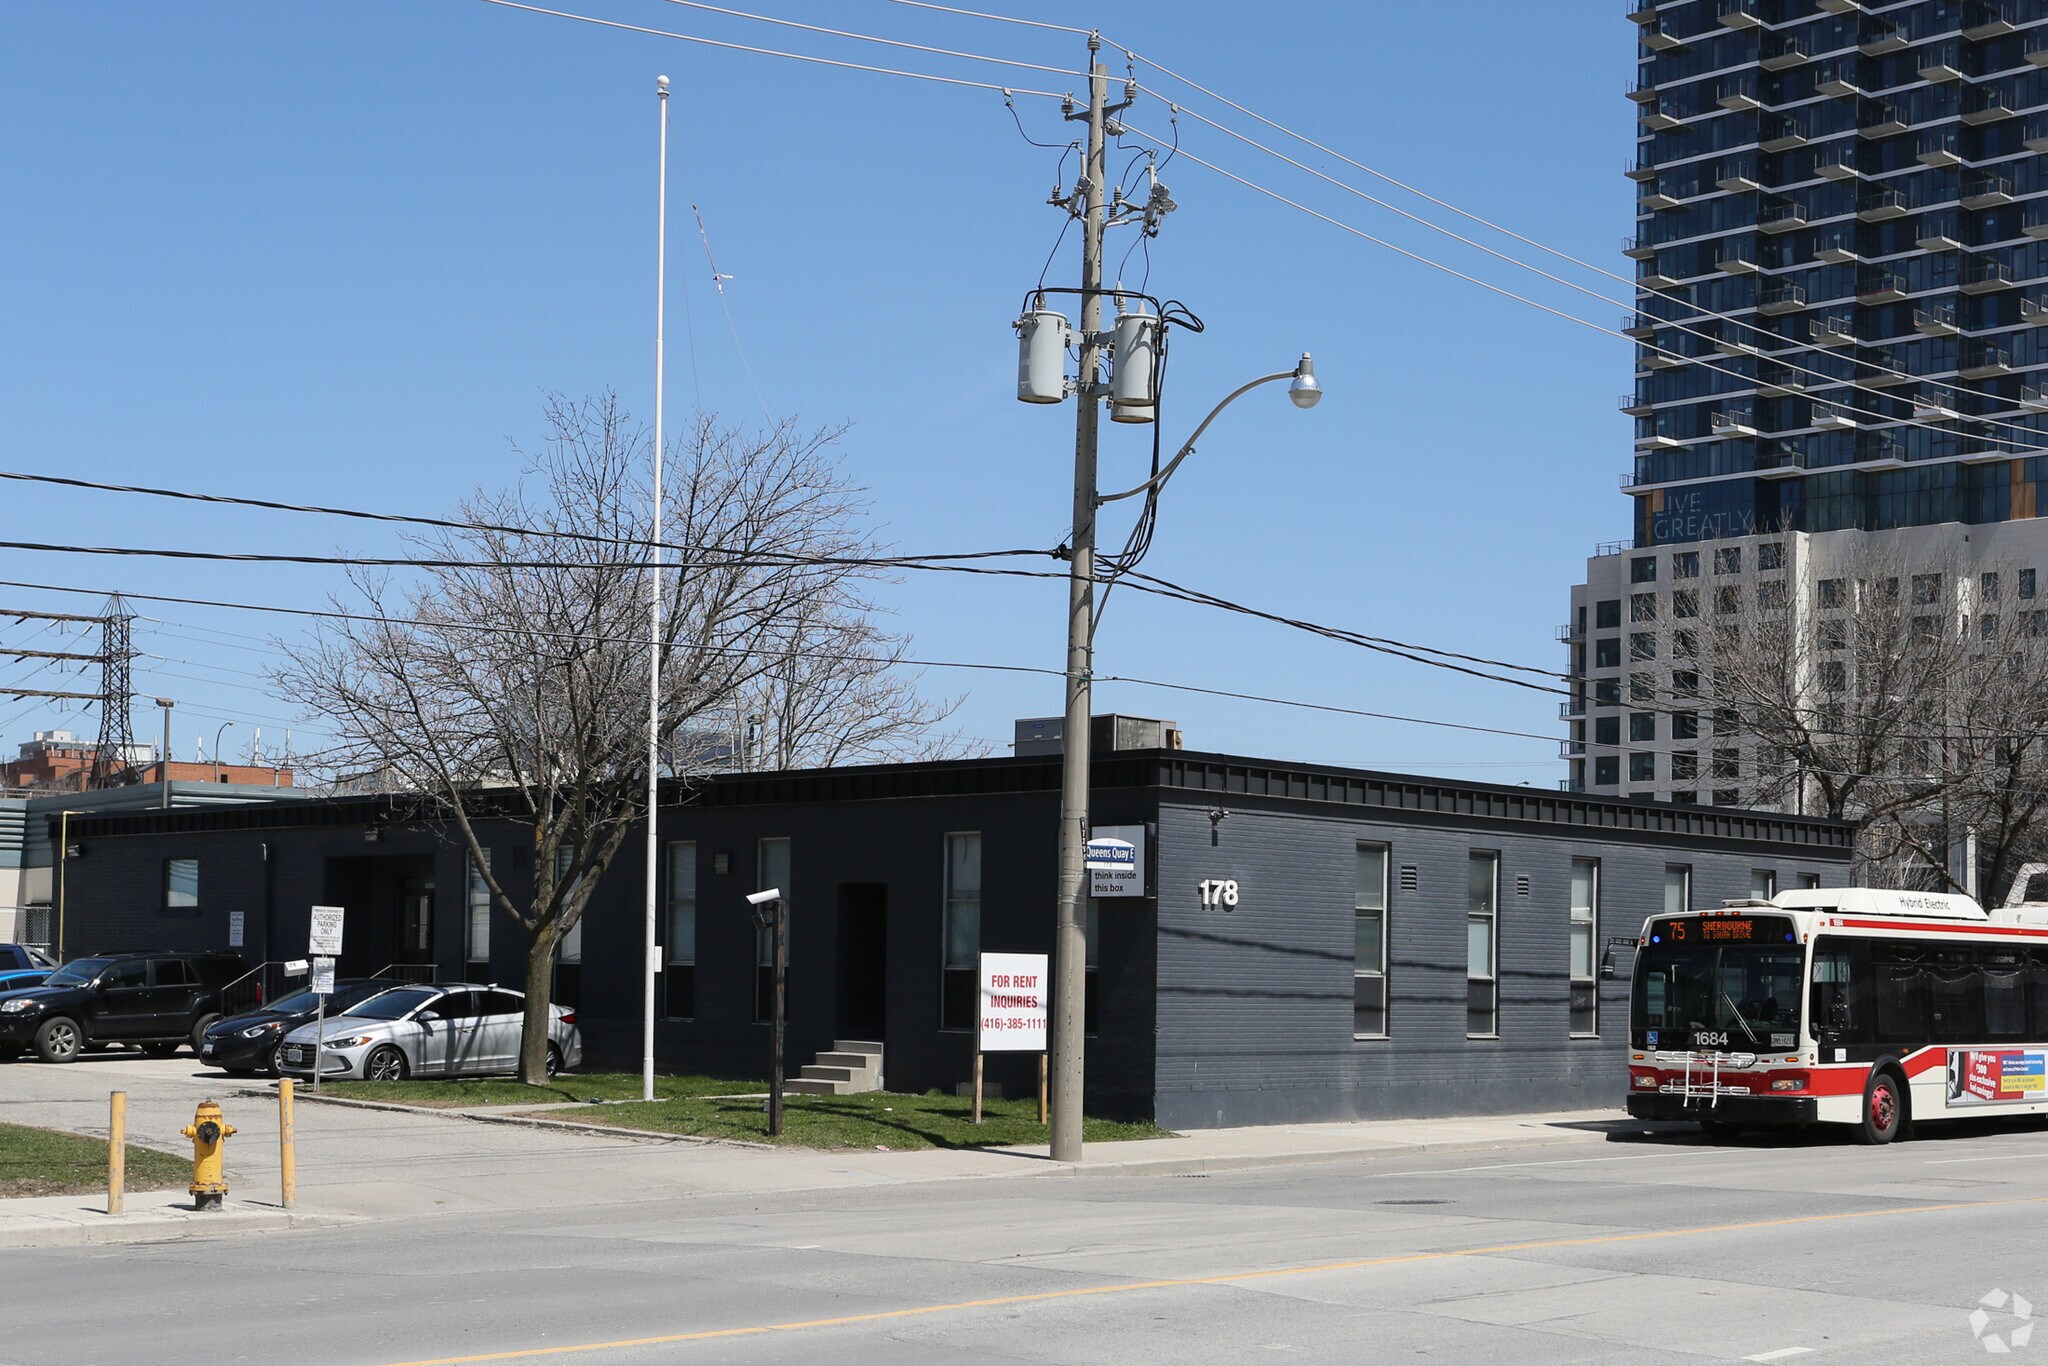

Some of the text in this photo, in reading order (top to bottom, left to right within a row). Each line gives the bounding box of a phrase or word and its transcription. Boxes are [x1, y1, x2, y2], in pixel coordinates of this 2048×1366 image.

[1656, 492, 1701, 516] IVE
[1654, 510, 1752, 539] GREATLY
[1086, 846, 1134, 861] Queens Quay E
[1095, 871, 1137, 880] think inside
[1095, 883, 1124, 892] this box
[1199, 879, 1239, 906] 178
[1900, 896, 1951, 911] Hybrid Electric
[313, 914, 343, 922] AUTHORIZED
[316, 921, 337, 929] PARKING
[1670, 920, 1753, 940] 75 SHERBOURNE
[991, 975, 1038, 988] FOR RENT
[990, 995, 1038, 1009] INQUIRIES
[981, 1018, 1047, 1031] (416)-385-1111
[1694, 1032, 1729, 1046] 1684
